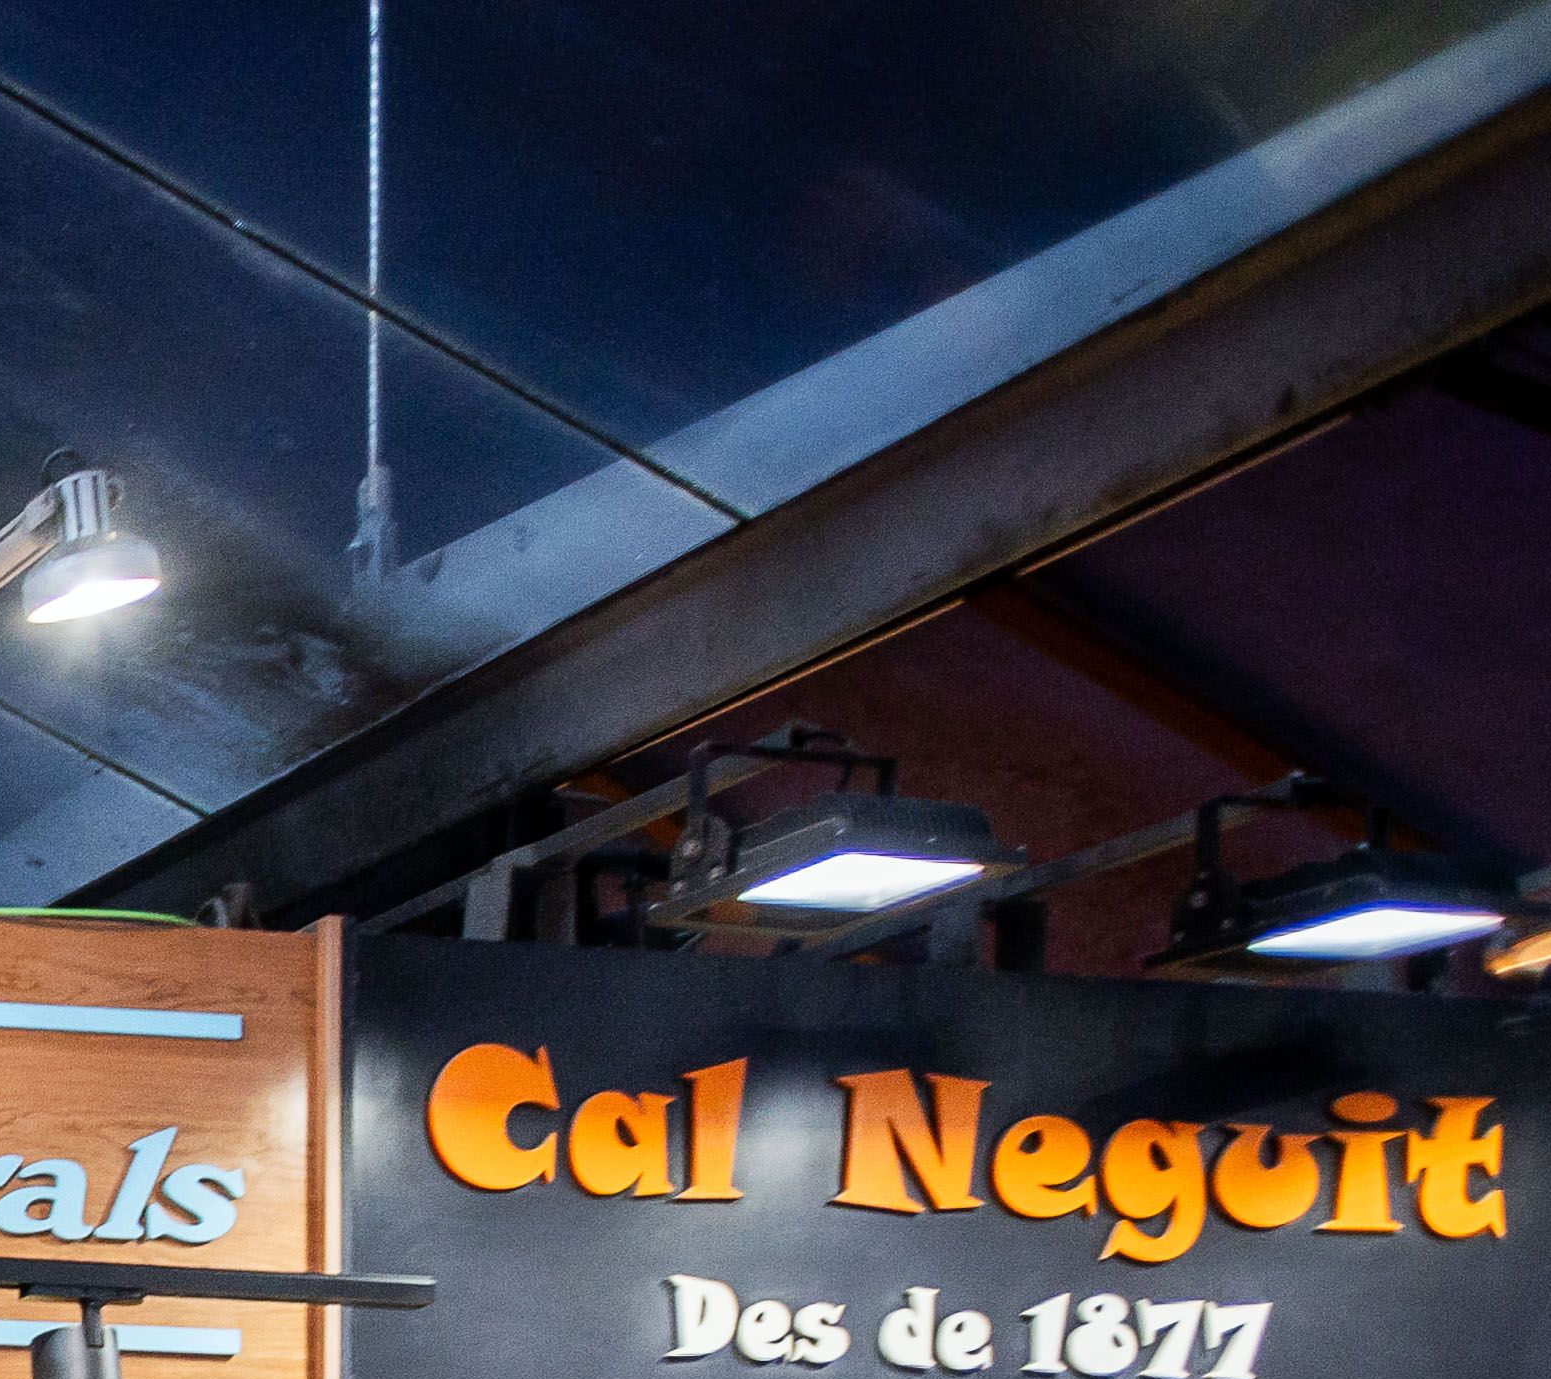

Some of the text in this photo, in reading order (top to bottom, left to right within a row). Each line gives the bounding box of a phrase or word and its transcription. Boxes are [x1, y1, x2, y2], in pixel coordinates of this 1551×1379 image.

[426, 1042, 1509, 1264] Cal Neguit
[662, 1272, 849, 1366] Des
[877, 1288, 993, 1374] de
